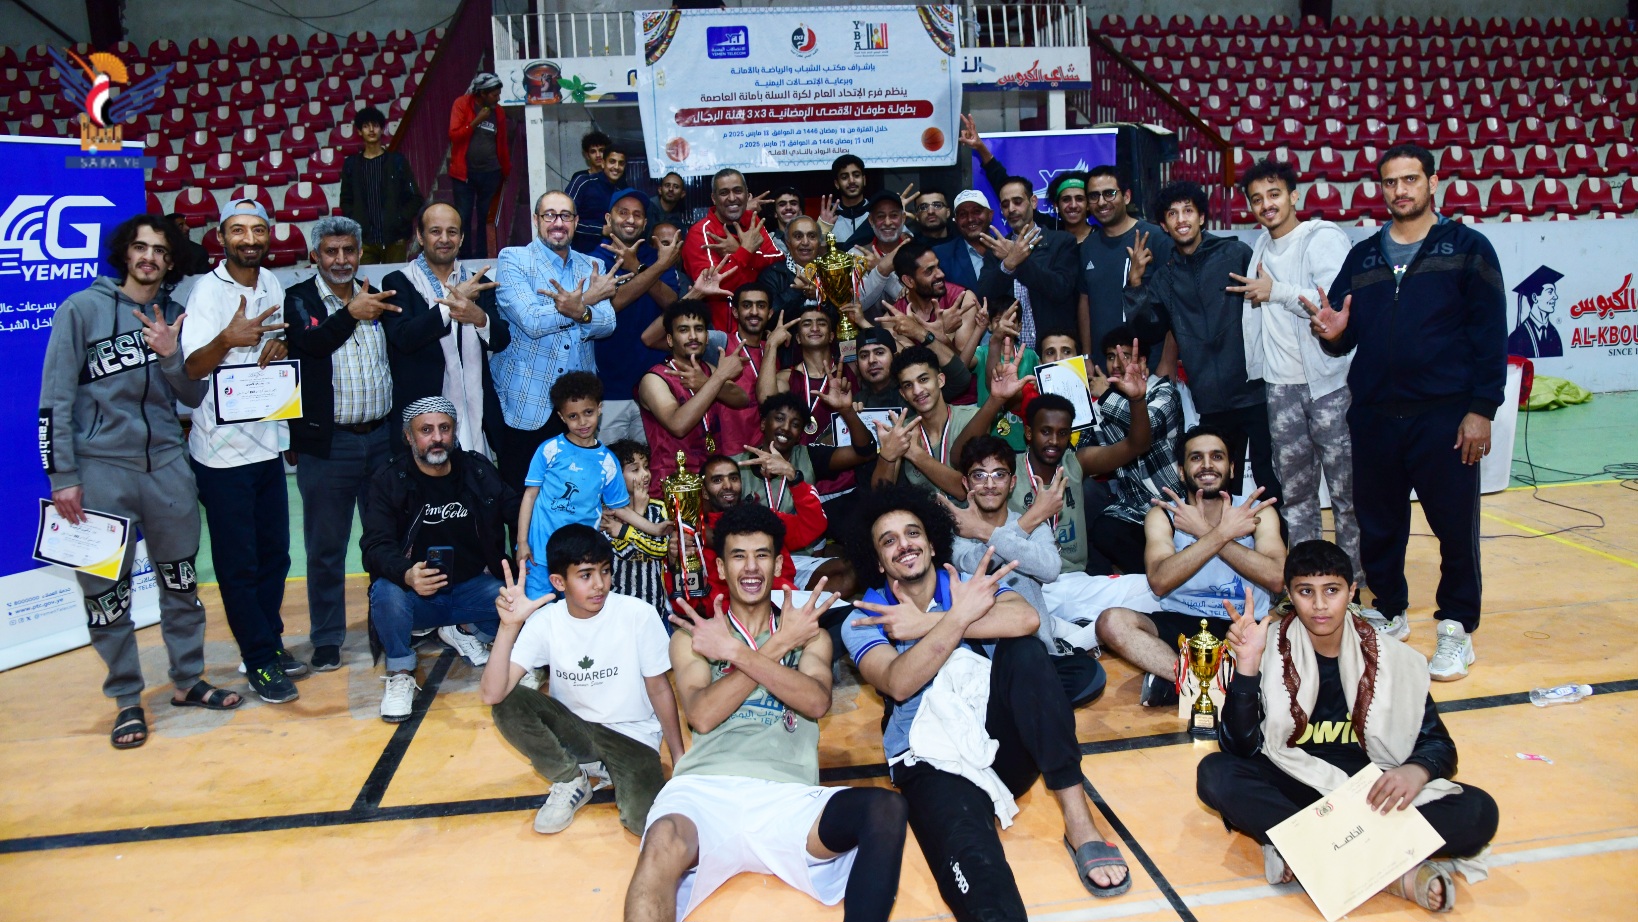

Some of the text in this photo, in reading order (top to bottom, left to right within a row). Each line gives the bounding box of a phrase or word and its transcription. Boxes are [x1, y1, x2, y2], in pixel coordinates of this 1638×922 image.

[761, 66, 792, 74] والرياضة
[795, 64, 821, 73] الشباب
[997, 59, 1080, 87] شاي الكبوس
[754, 79, 784, 87] اليمنية
[700, 92, 737, 103] العاصمة
[738, 91, 763, 102] بأمانة
[765, 90, 790, 100] السلة
[792, 90, 811, 99] لكرة
[814, 89, 836, 100] العام
[868, 89, 884, 98] فرع
[885, 88, 908, 98] ينظم
[854, 105, 886, 116] طوفان
[888, 104, 916, 115] بطولة
[692, 110, 723, 124] الرجال
[788, 139, 810, 148] الموافق
[834, 138, 853, 146] رمضان
[862, 137, 874, 145] إلى
[21, 262, 98, 281] YEMEN
[1570, 273, 1637, 320] الكبوس
[16, 302, 57, 314] بسرعات
[31, 317, 53, 331] اخل
[1608, 348, 1633, 357] SINCE
[15, 598, 64, 614] www.ptc.gov.ye
[556, 666, 618, 682] DSQUARED2
[1331, 825, 1365, 851] الخاصة
